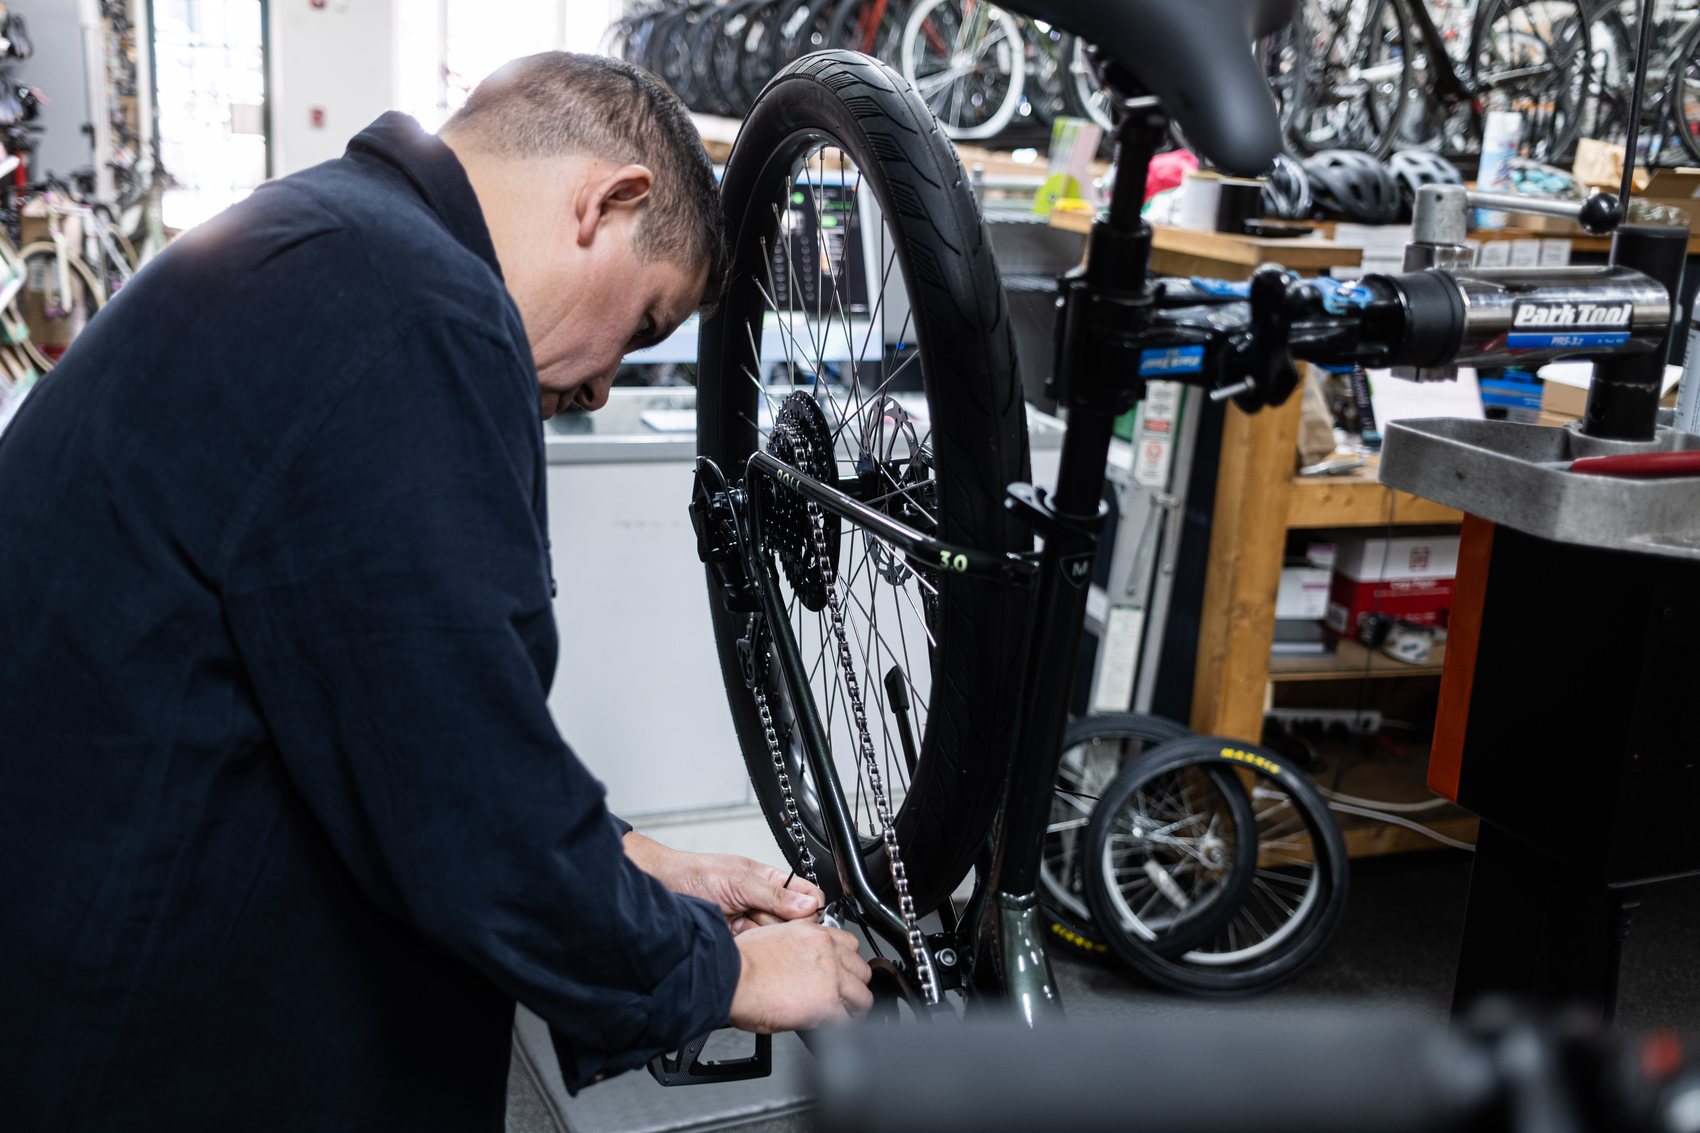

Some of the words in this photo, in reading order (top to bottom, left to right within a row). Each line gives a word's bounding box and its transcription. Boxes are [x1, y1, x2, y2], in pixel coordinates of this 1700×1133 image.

[1513, 304, 1576, 326] Park
[1577, 303, 1632, 325] Tool
[939, 550, 968, 571] 3.0
